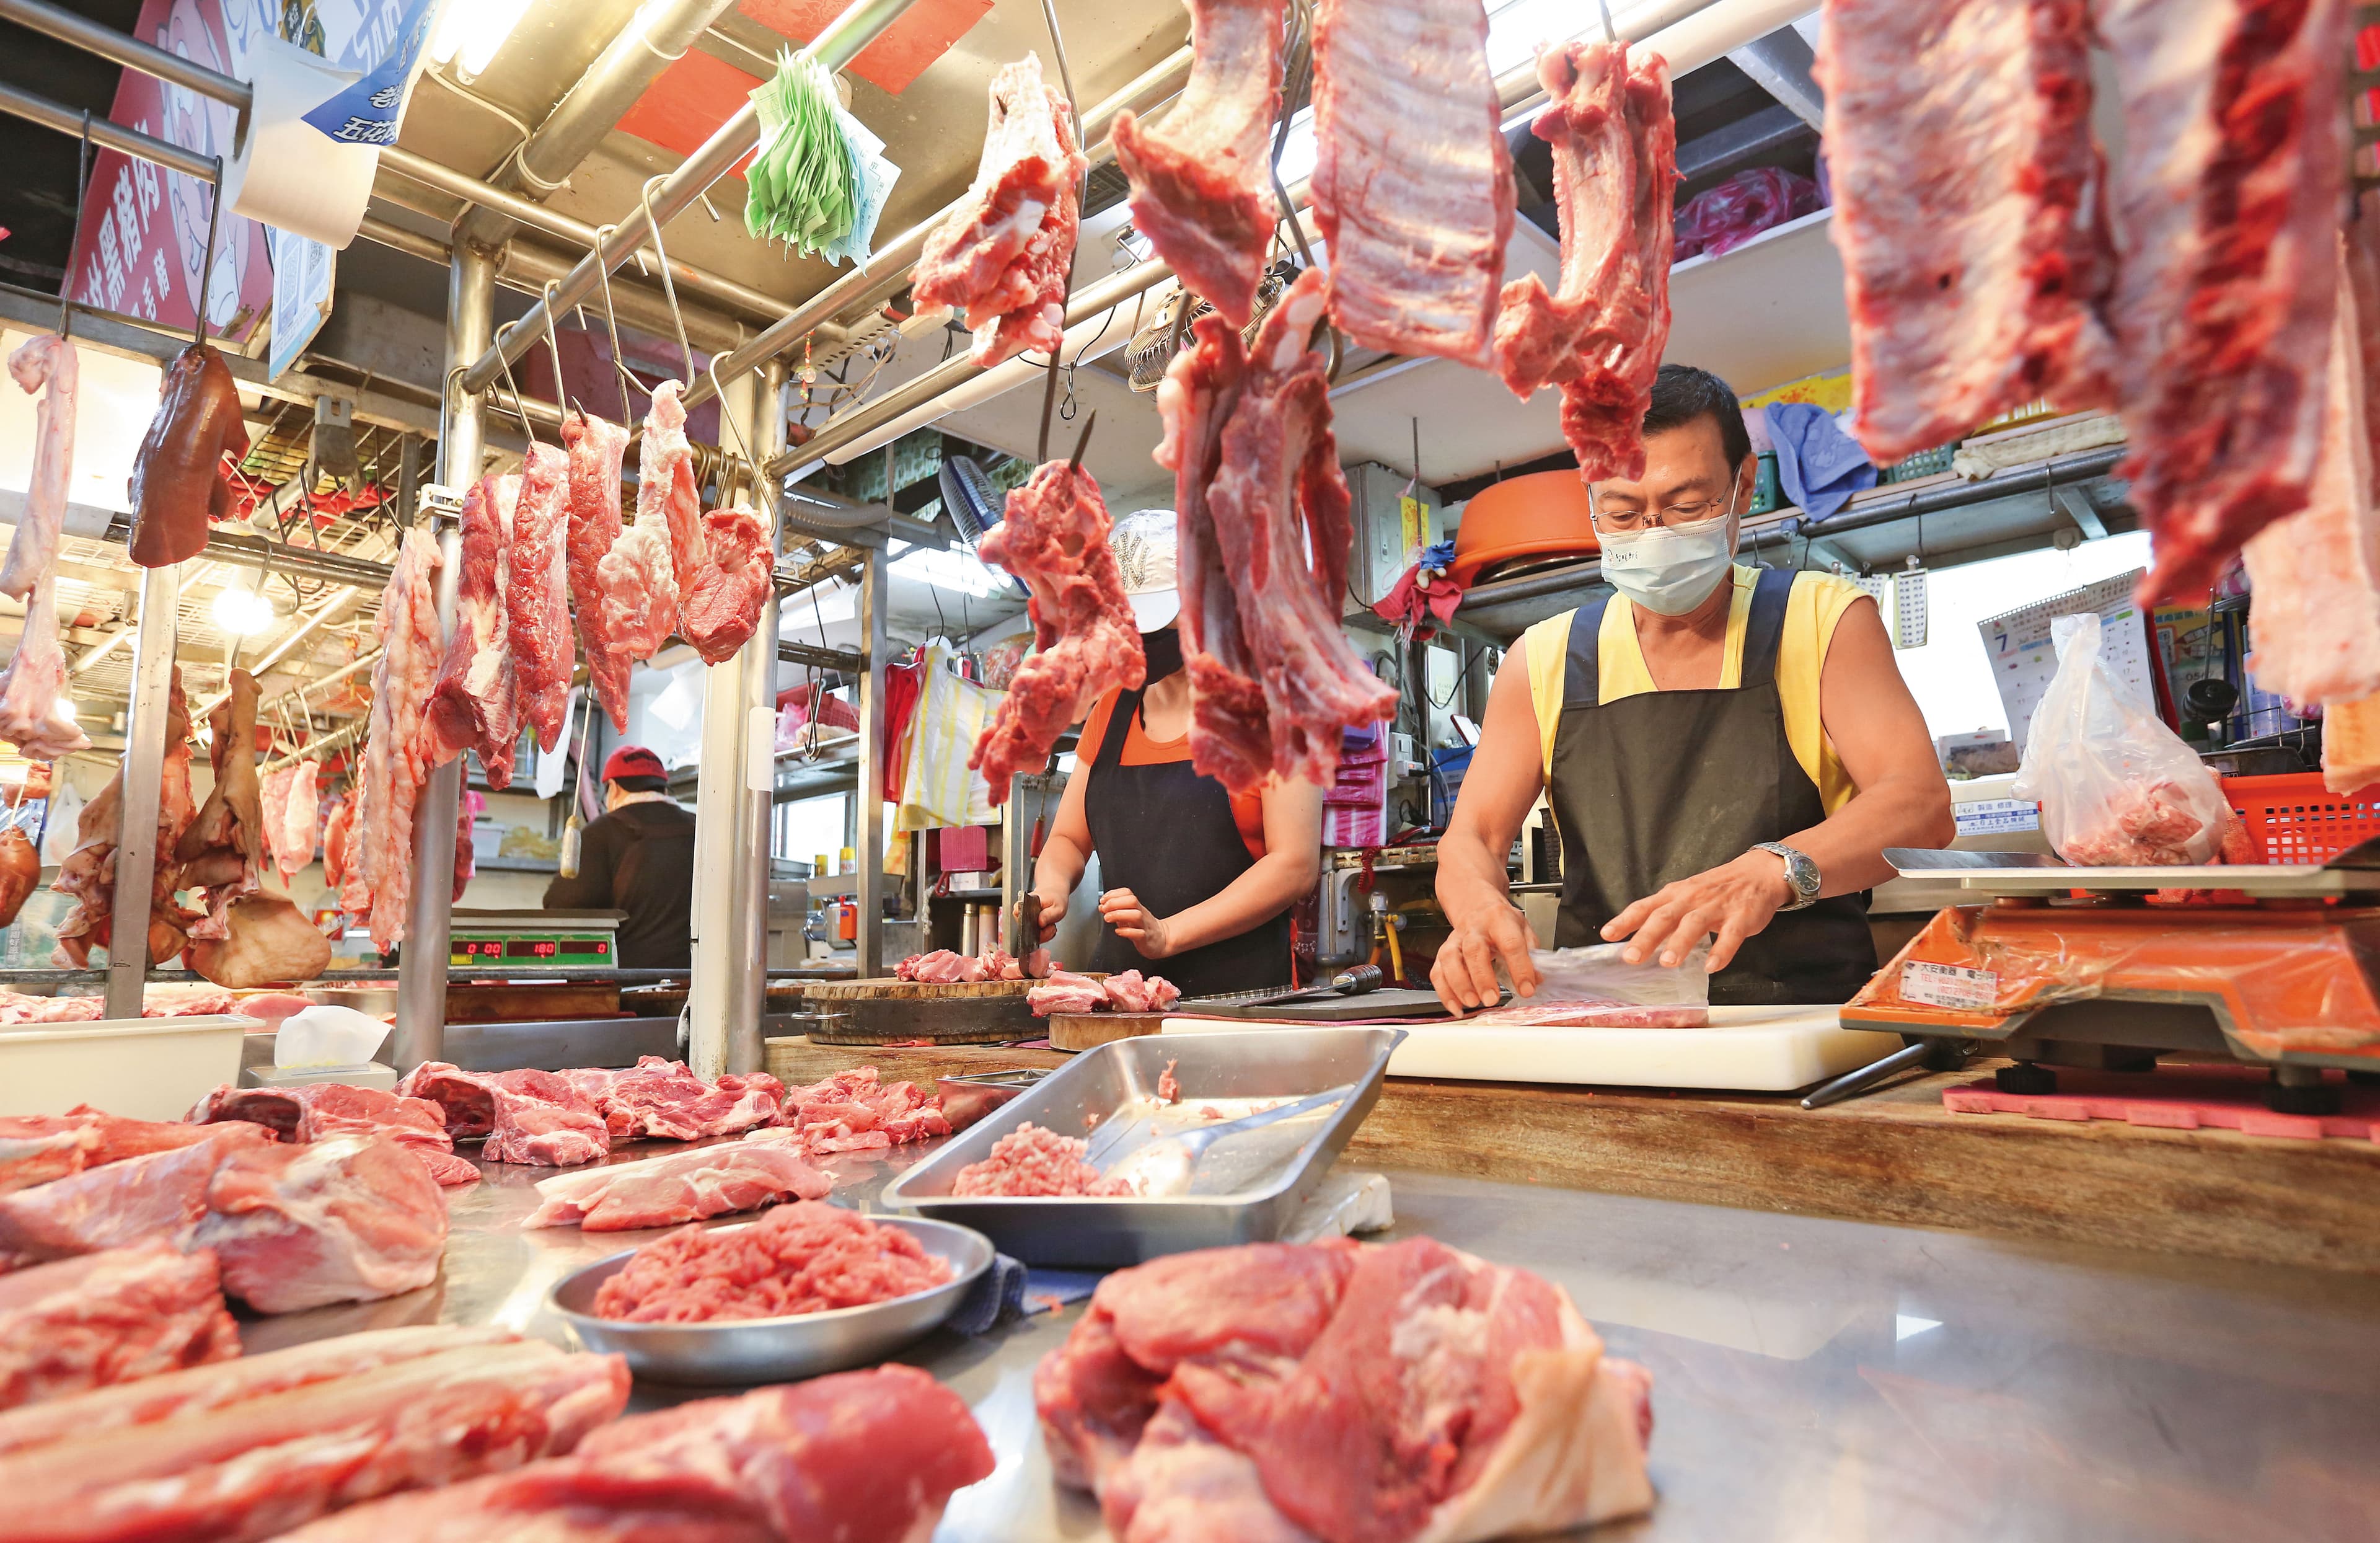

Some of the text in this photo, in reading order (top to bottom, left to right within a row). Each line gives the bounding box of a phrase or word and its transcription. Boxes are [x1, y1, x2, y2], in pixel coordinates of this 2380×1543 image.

[1994, 634, 2008, 652] 7
[534, 944, 553, 953] 180
[597, 944, 606, 953] 0
[1921, 964, 1957, 976] 大安衡器
